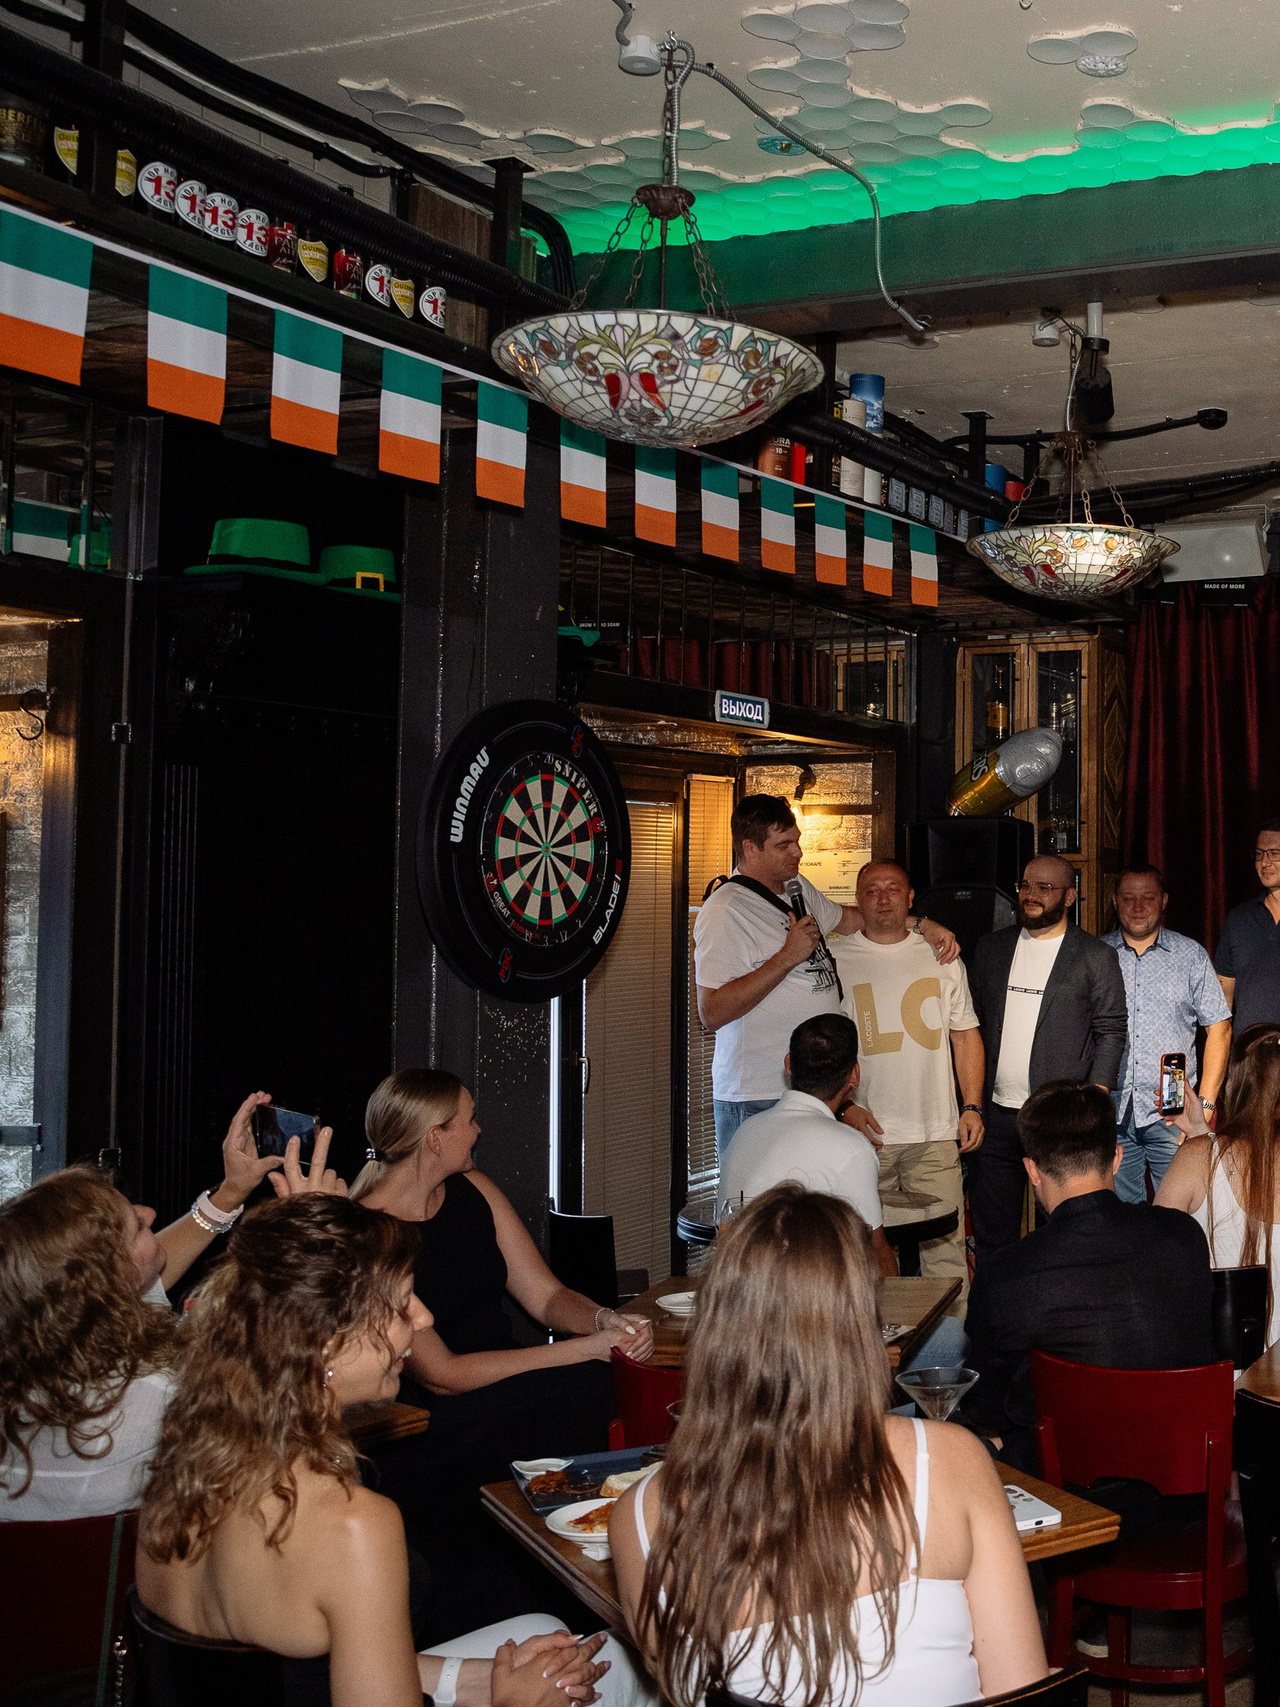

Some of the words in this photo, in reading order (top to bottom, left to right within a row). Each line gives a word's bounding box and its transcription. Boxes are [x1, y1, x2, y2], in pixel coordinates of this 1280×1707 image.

[151, 193, 174, 208] LAGE
[220, 197, 237, 212] HOU
[205, 206, 236, 231] 13
[241, 222, 268, 247] 13
[721, 698, 763, 721] ВЫХОД
[450, 747, 490, 843] WINMAU
[554, 759, 598, 817] SNIPER
[493, 891, 511, 918] GREAT
[852, 977, 943, 1056] LC
[863, 1010, 873, 1047] LACOSTE
